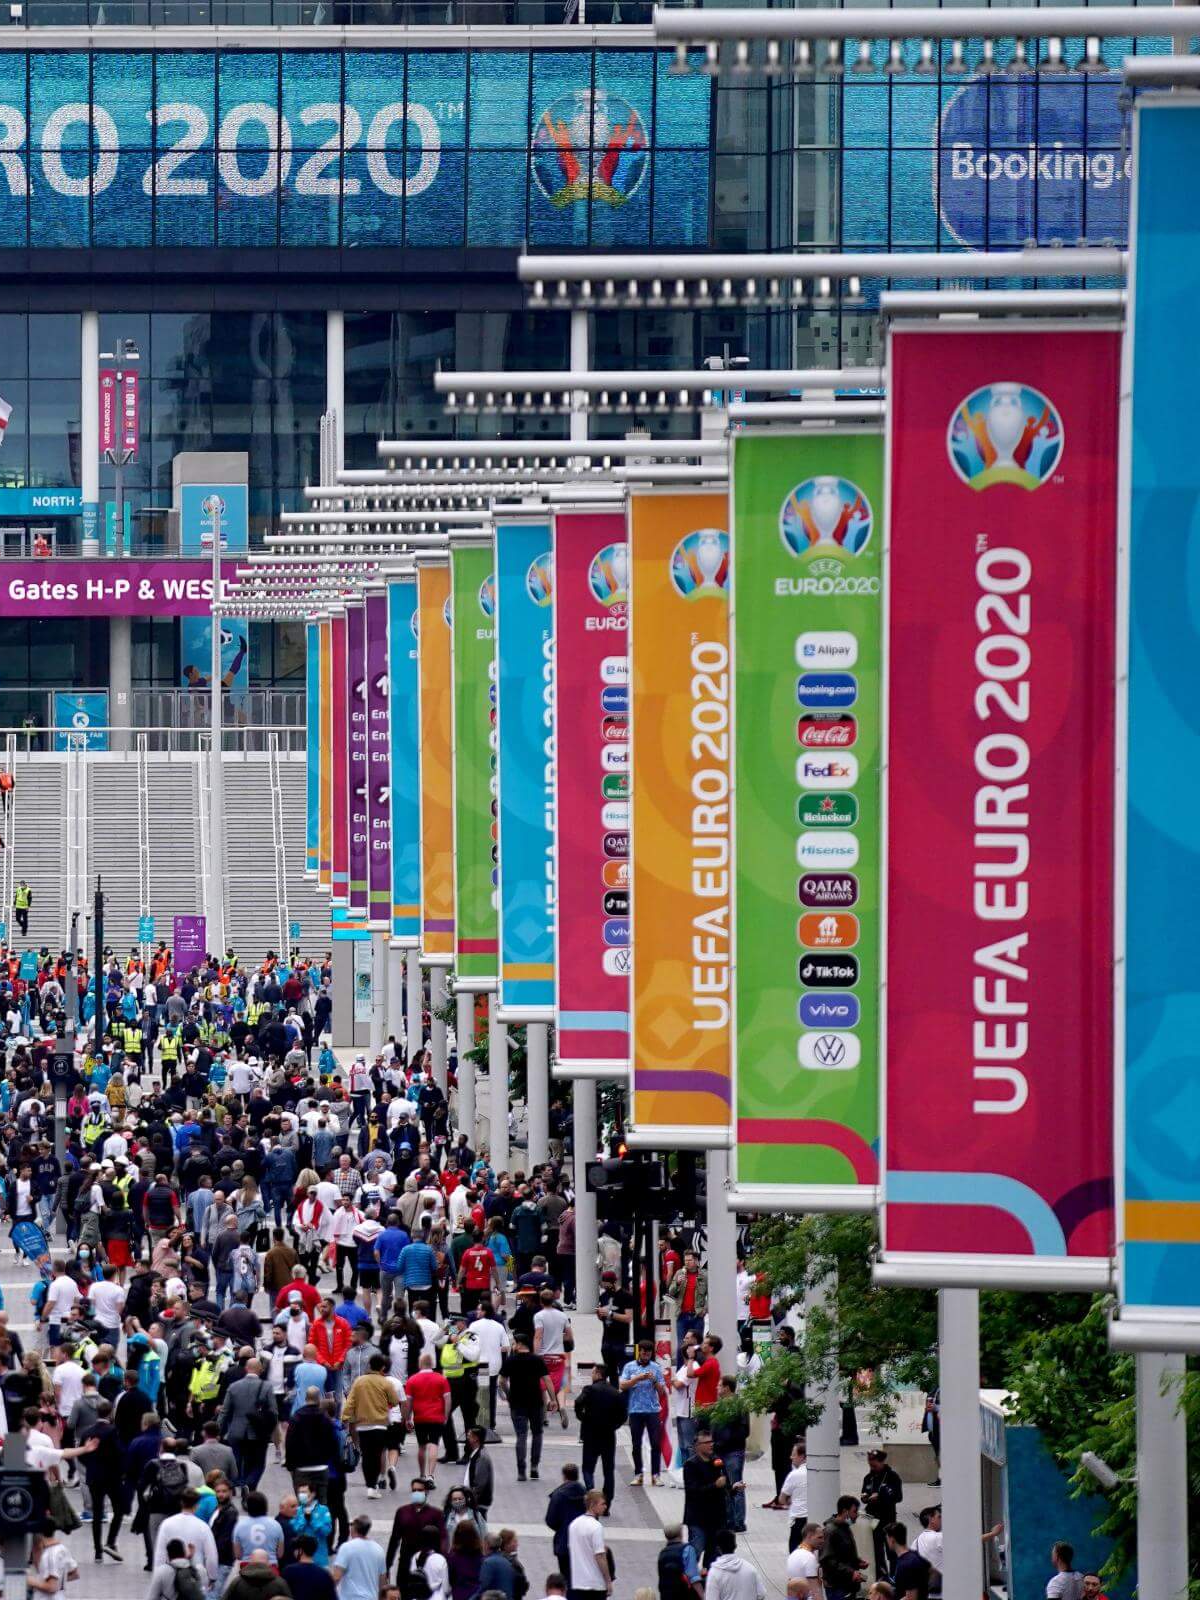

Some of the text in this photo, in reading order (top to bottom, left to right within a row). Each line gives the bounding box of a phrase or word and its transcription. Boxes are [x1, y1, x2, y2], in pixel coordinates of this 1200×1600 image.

[142, 102, 443, 198] 2020
[33, 496, 74, 507] NORTH
[9, 579, 78, 600] Gates
[87, 579, 131, 600] H-P
[139, 579, 156, 600] &
[775, 577, 880, 595] EURO2020
[974, 547, 1033, 725] 2020
[818, 645, 850, 656] Alipay
[690, 639, 730, 761] 2020
[799, 685, 855, 697] Booking.com
[804, 763, 849, 777] FedEx
[803, 812, 851, 823] Heineken
[691, 763, 730, 900] EURO
[973, 733, 1032, 922] EURO
[802, 845, 854, 855] Hisense
[803, 880, 851, 894] QATAR
[691, 903, 731, 1030] UEFA
[816, 966, 854, 978] TikTok
[809, 1005, 848, 1016] vivo
[973, 930, 1031, 1115] UEFA
[250, 1524, 266, 1545] 6
